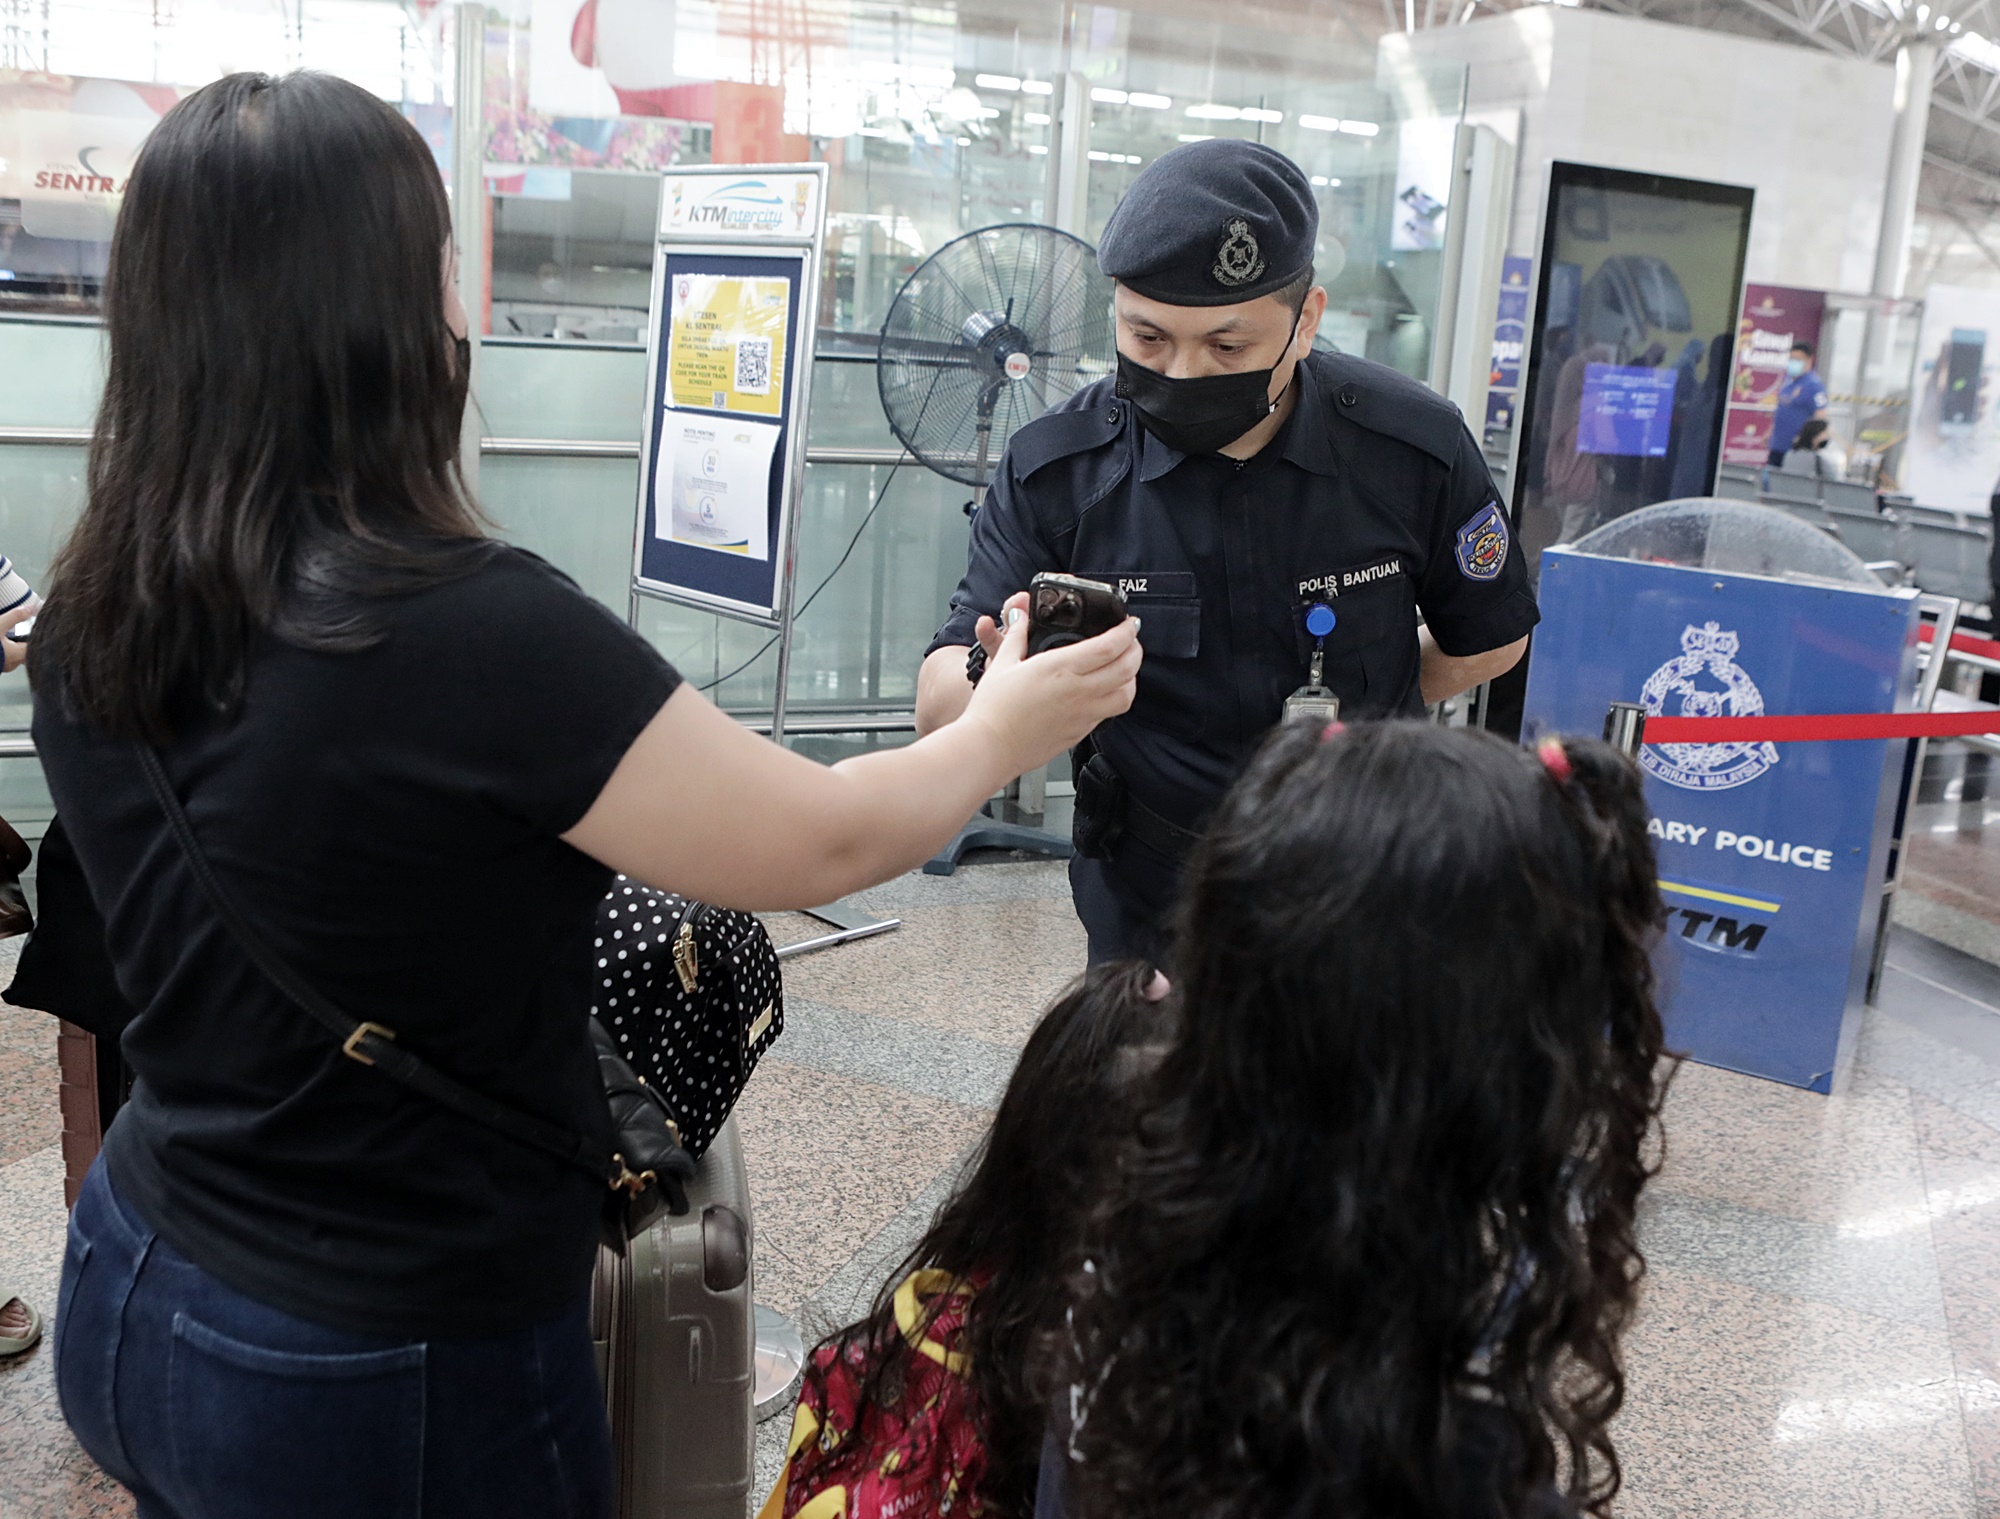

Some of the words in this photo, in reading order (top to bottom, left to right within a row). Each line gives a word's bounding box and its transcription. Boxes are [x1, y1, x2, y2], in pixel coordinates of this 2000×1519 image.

[695, 322, 722, 331] SENTRAL
[688, 378, 712, 386] SCHEDULE
[1118, 579, 1147, 592] FAIZ
[1299, 575, 1337, 596] POLIS
[1343, 560, 1400, 586] BANTUAN
[1658, 766, 1701, 786] DIRAJA
[1704, 759, 1764, 787] MALAYSIA
[1646, 817, 1708, 846] ARY
[1715, 830, 1834, 872] POLICE
